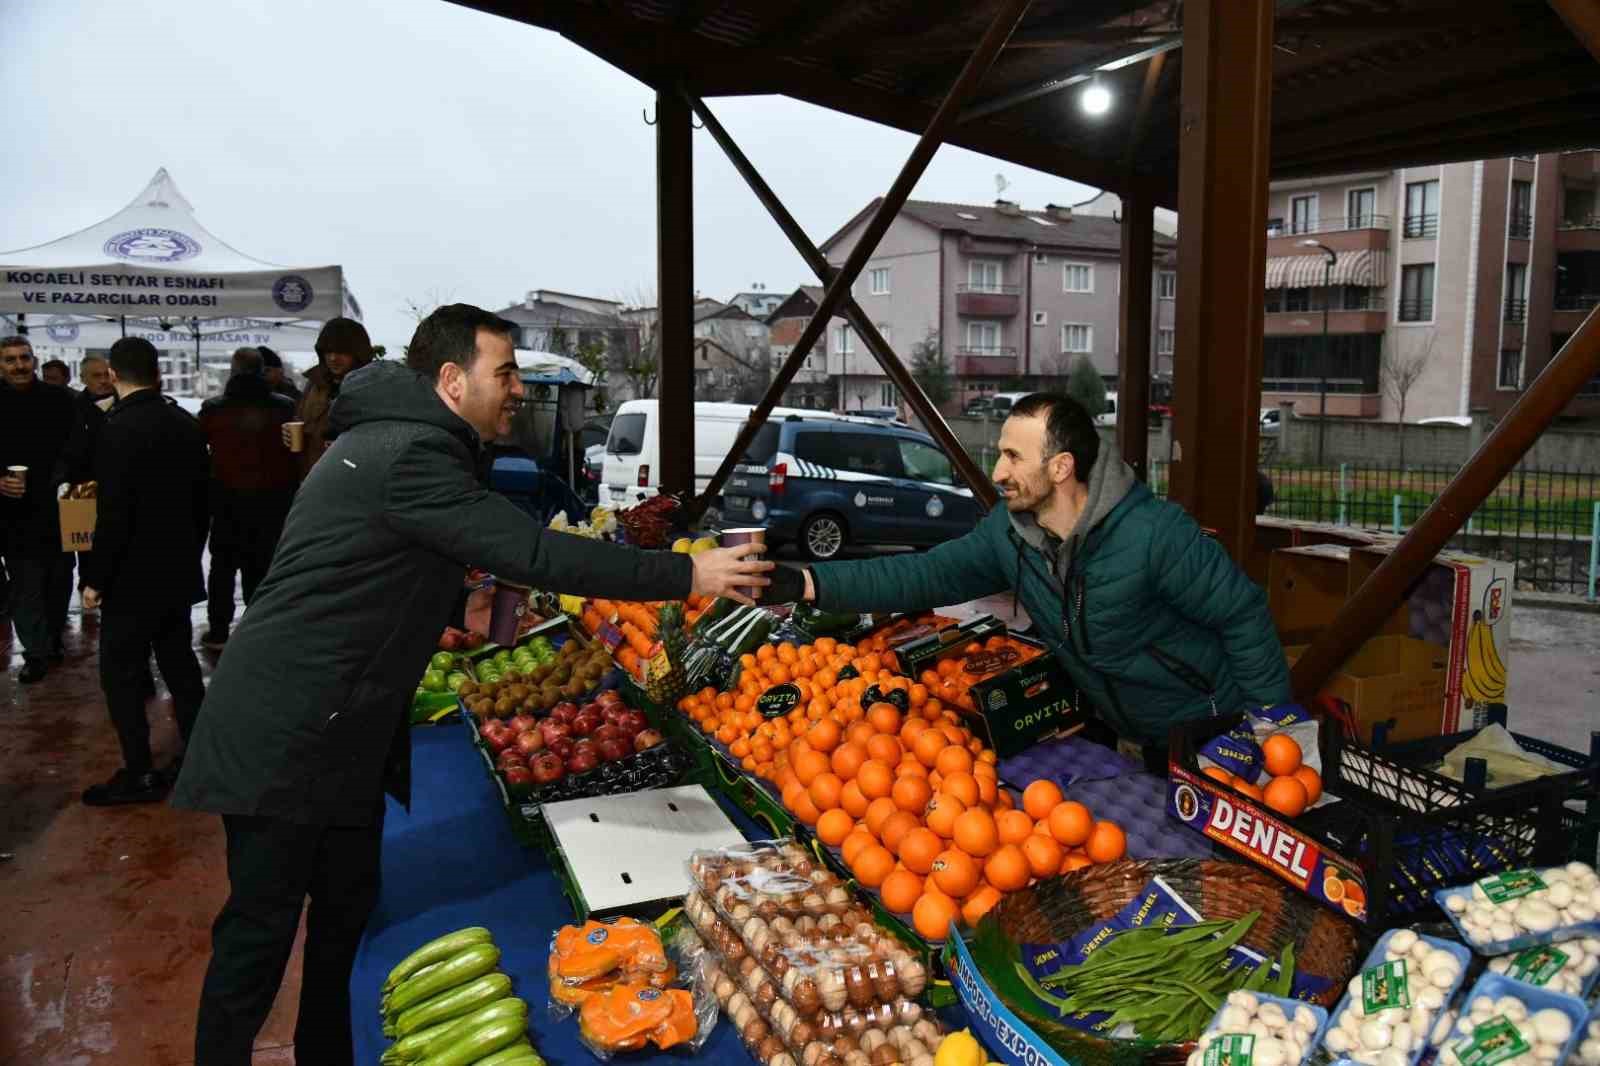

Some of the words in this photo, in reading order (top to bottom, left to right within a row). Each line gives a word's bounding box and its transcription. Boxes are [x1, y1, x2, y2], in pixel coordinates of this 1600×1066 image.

[6, 271, 84, 285] KOCAELİ
[90, 273, 158, 288] SEYYAR
[164, 276, 224, 289] ESNAFI
[23, 291, 46, 303] VE
[52, 292, 160, 305] PAZARCILAR
[165, 294, 217, 306] ODASI
[759, 693, 796, 705] ORVITA
[1013, 698, 1072, 731] ORVITA
[1211, 797, 1309, 879] DENEL
[1135, 892, 1158, 926] DENEL
[1083, 926, 1113, 955] DENEL
